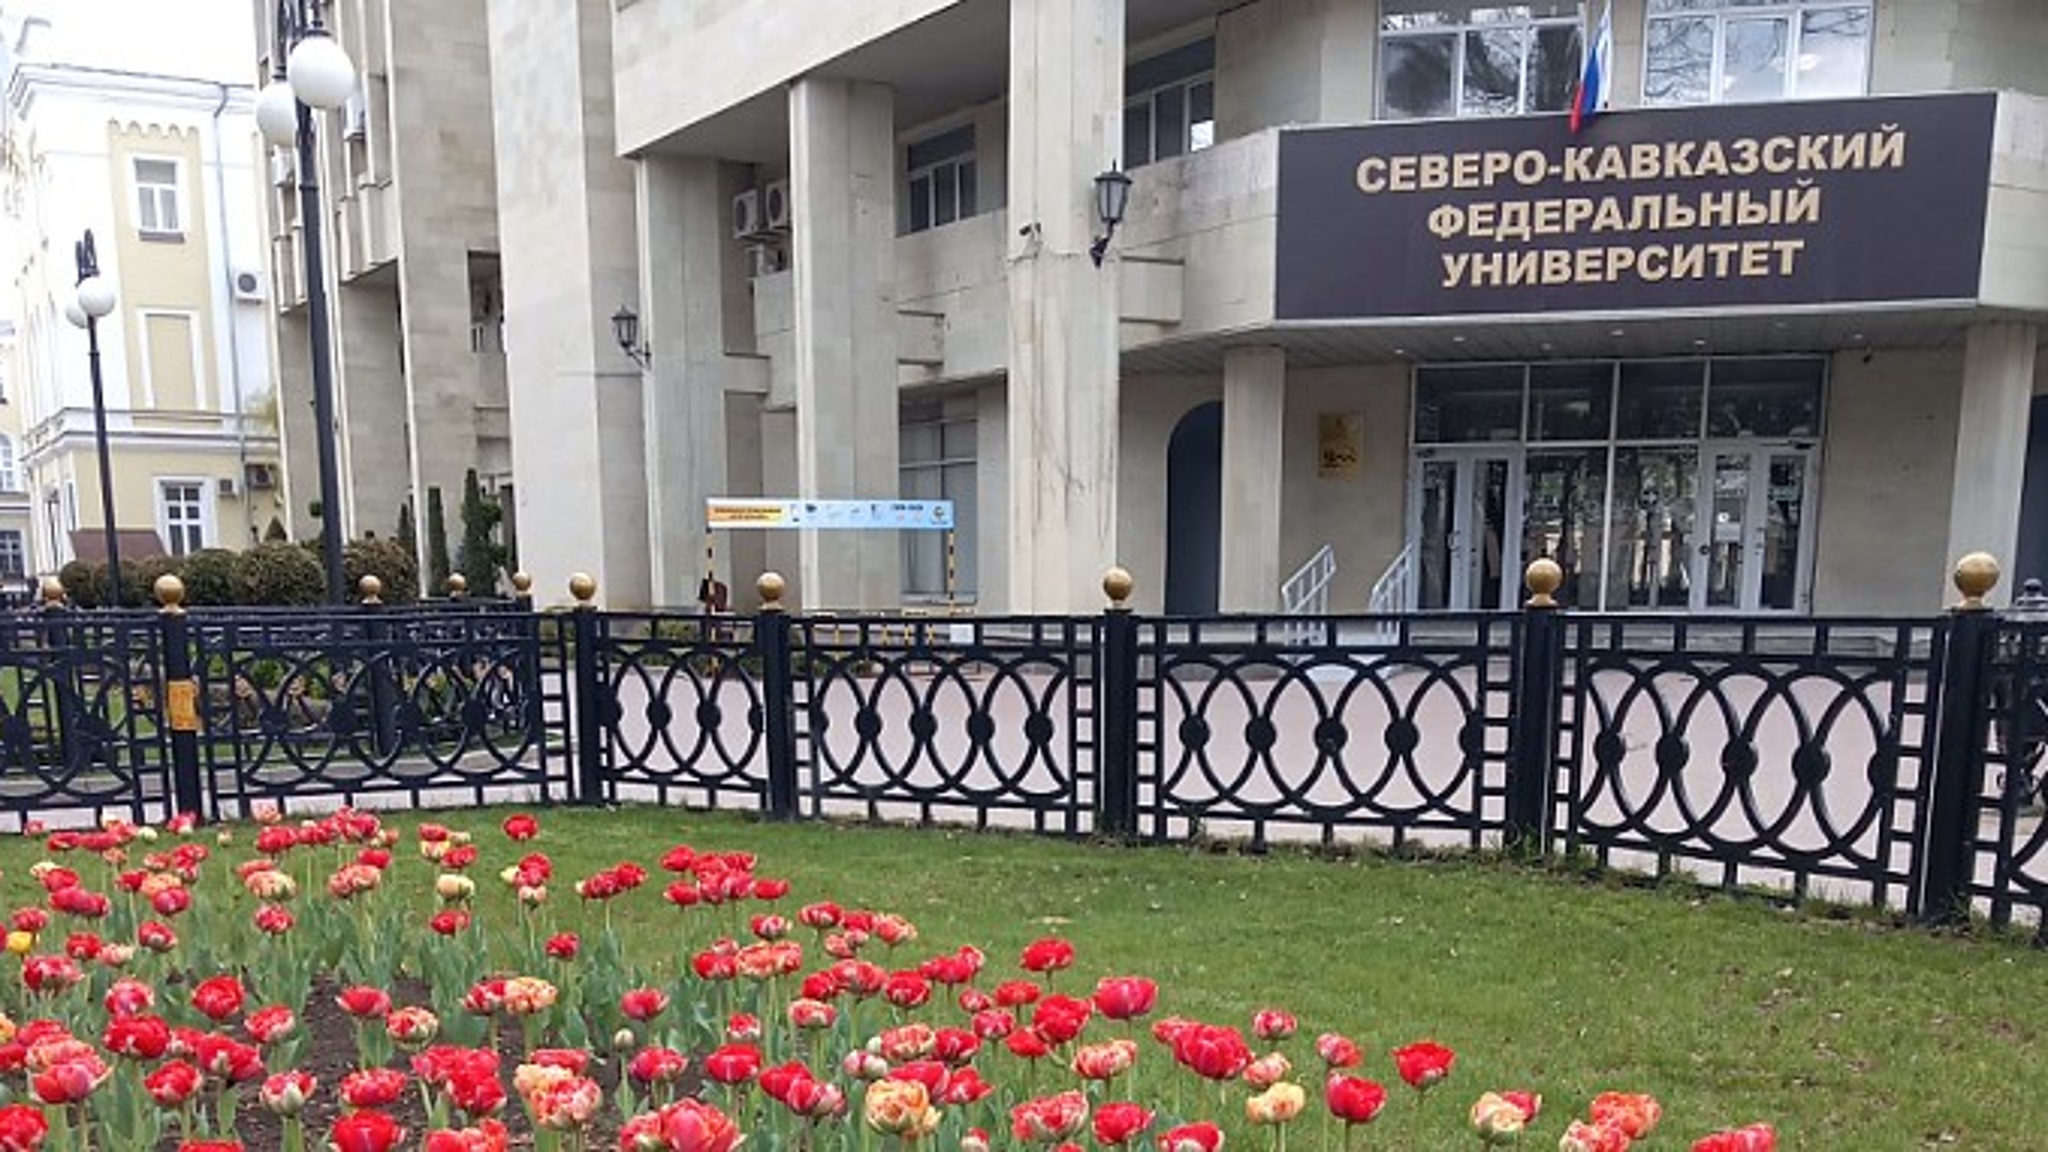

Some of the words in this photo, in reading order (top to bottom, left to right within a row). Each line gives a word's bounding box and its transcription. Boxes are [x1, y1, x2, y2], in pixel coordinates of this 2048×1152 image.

[1356, 123, 1906, 193] СЕВЕРО-КАВКАЗСКИЙ
[1428, 180, 1821, 242] ФЕДЕРАЛЬНЫЙ
[1441, 239, 1805, 288] УНИВЕРСИТЕТ
